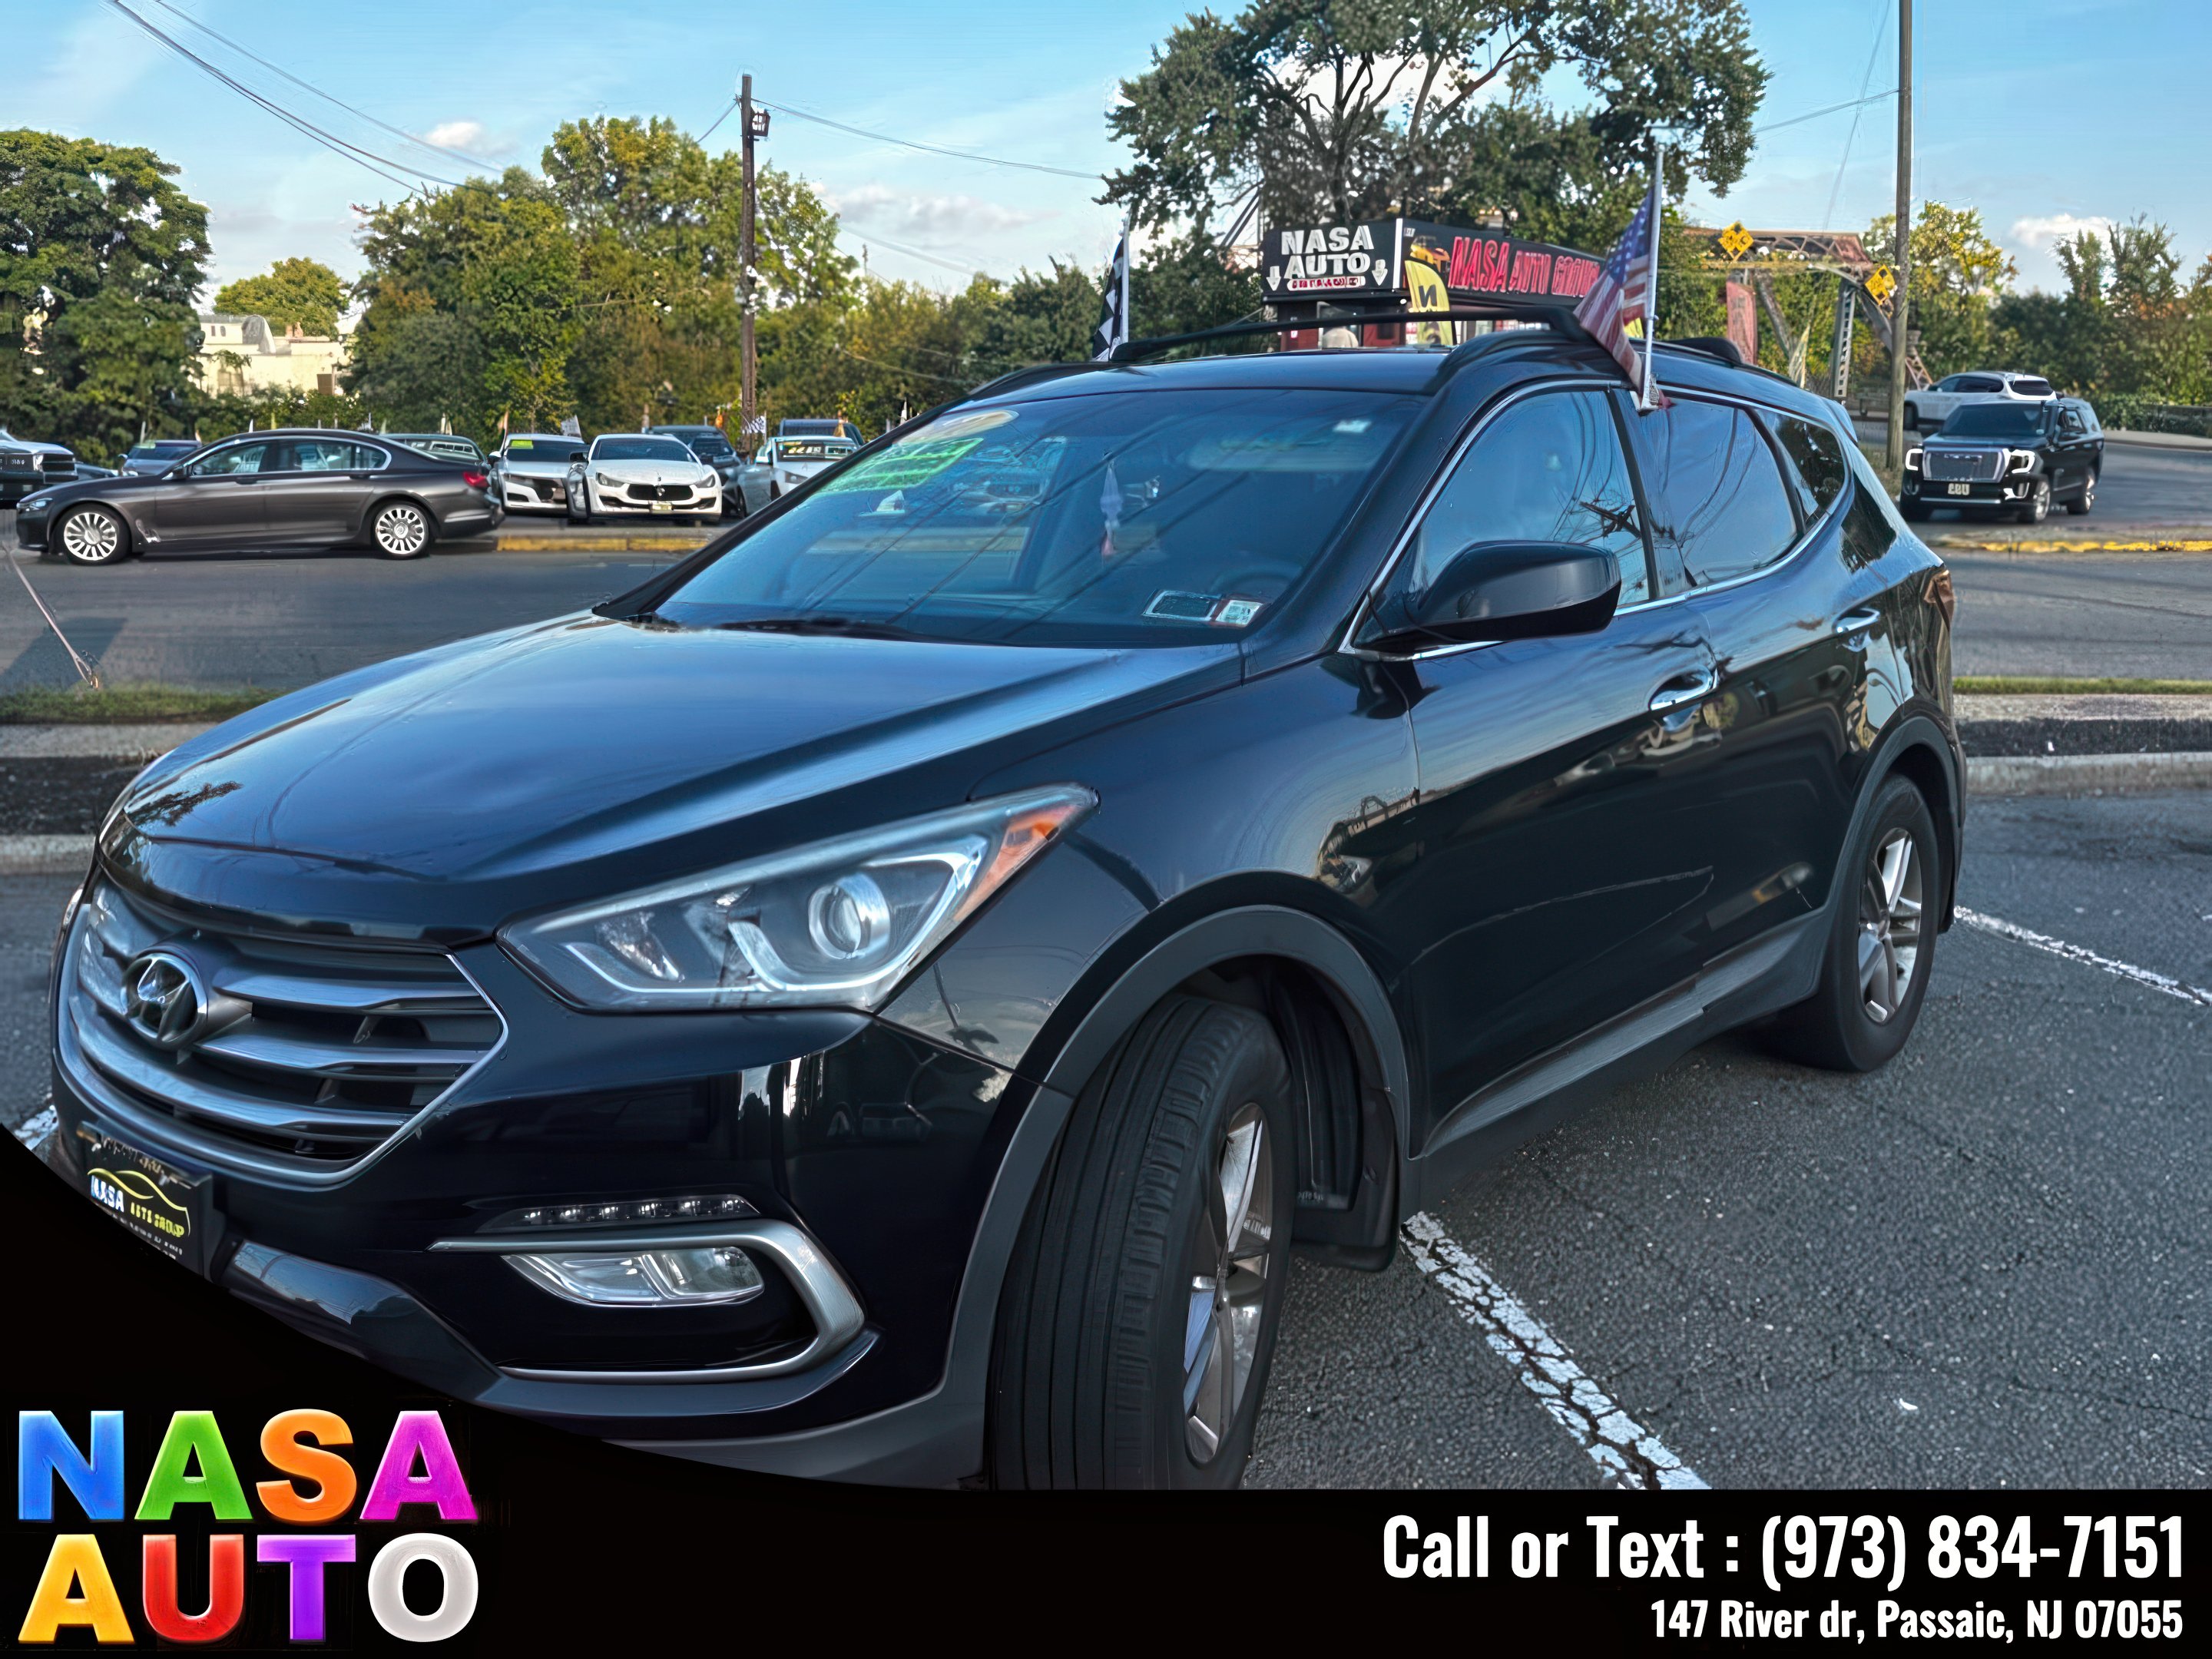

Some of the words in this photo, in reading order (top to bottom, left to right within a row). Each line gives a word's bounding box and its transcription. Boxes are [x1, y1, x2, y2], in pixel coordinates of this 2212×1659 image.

[1281, 225, 1374, 255] NASA
[1283, 252, 1370, 280] AUTO
[1447, 236, 1510, 293] NASA
